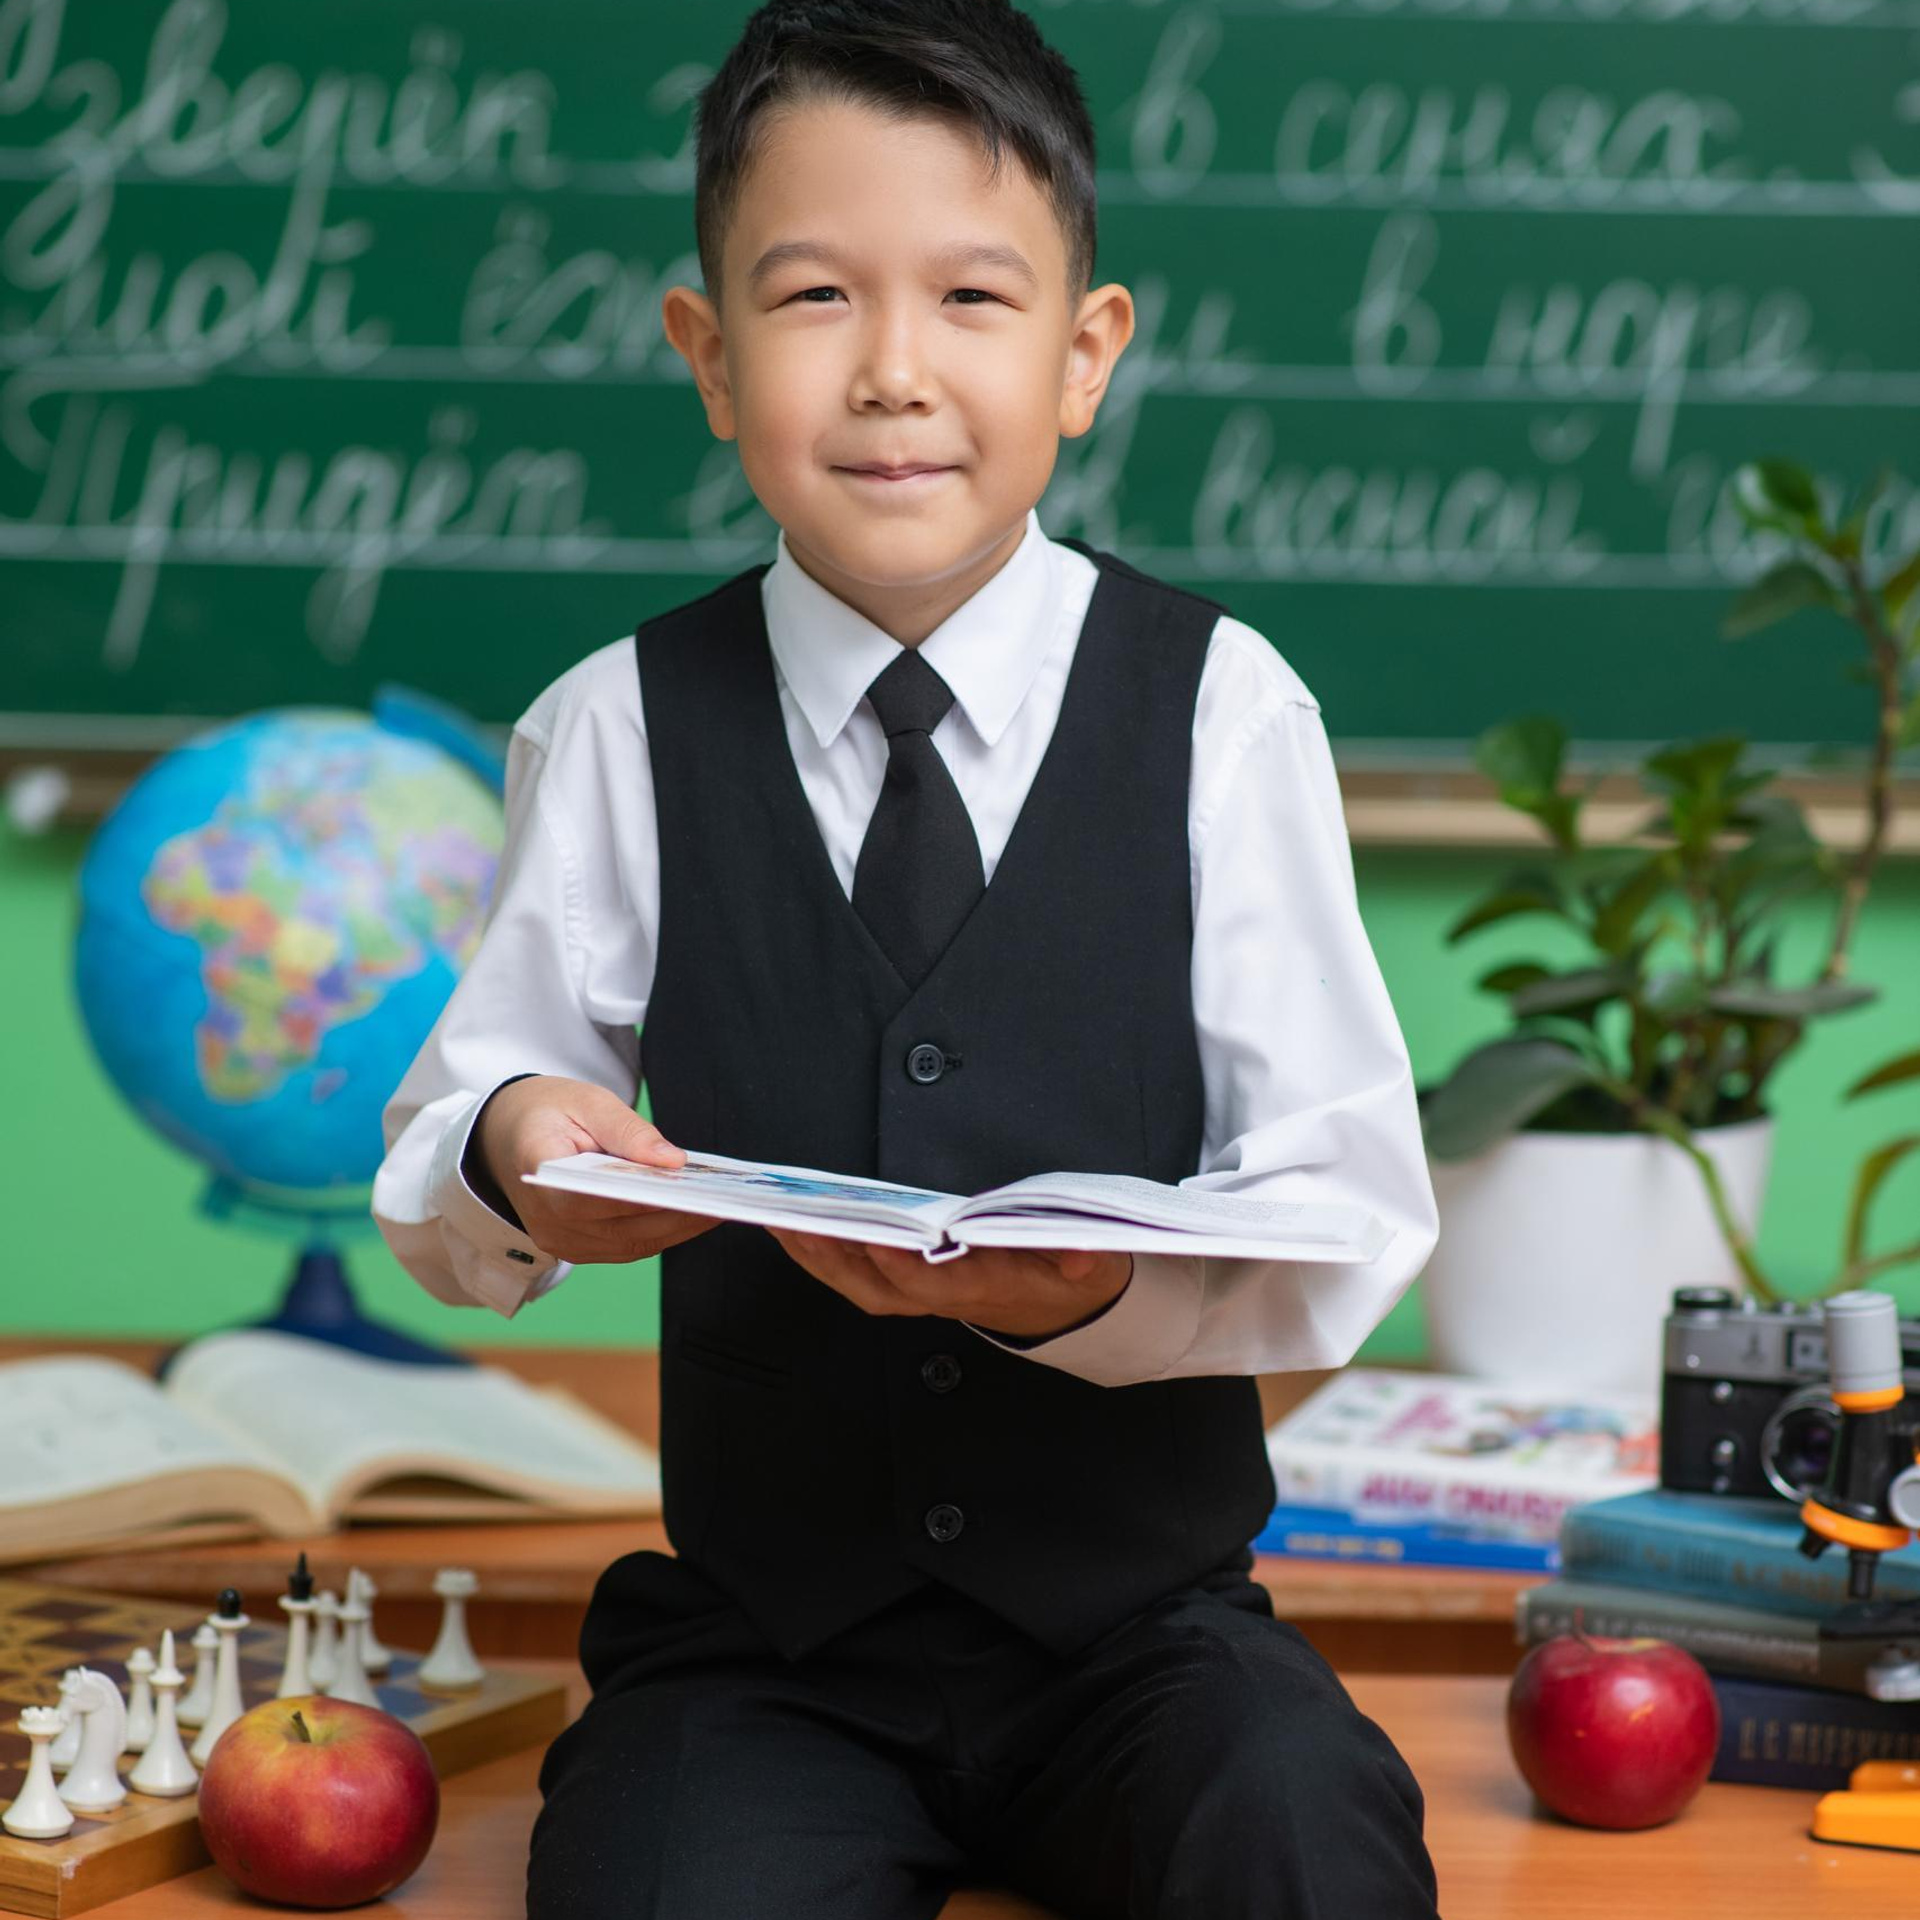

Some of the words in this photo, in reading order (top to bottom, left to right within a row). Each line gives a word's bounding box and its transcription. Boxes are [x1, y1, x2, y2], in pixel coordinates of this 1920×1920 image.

[1122, 3, 1223, 200] в
[1352, 207, 1442, 398] в
[0, 360, 618, 674] Придёт
